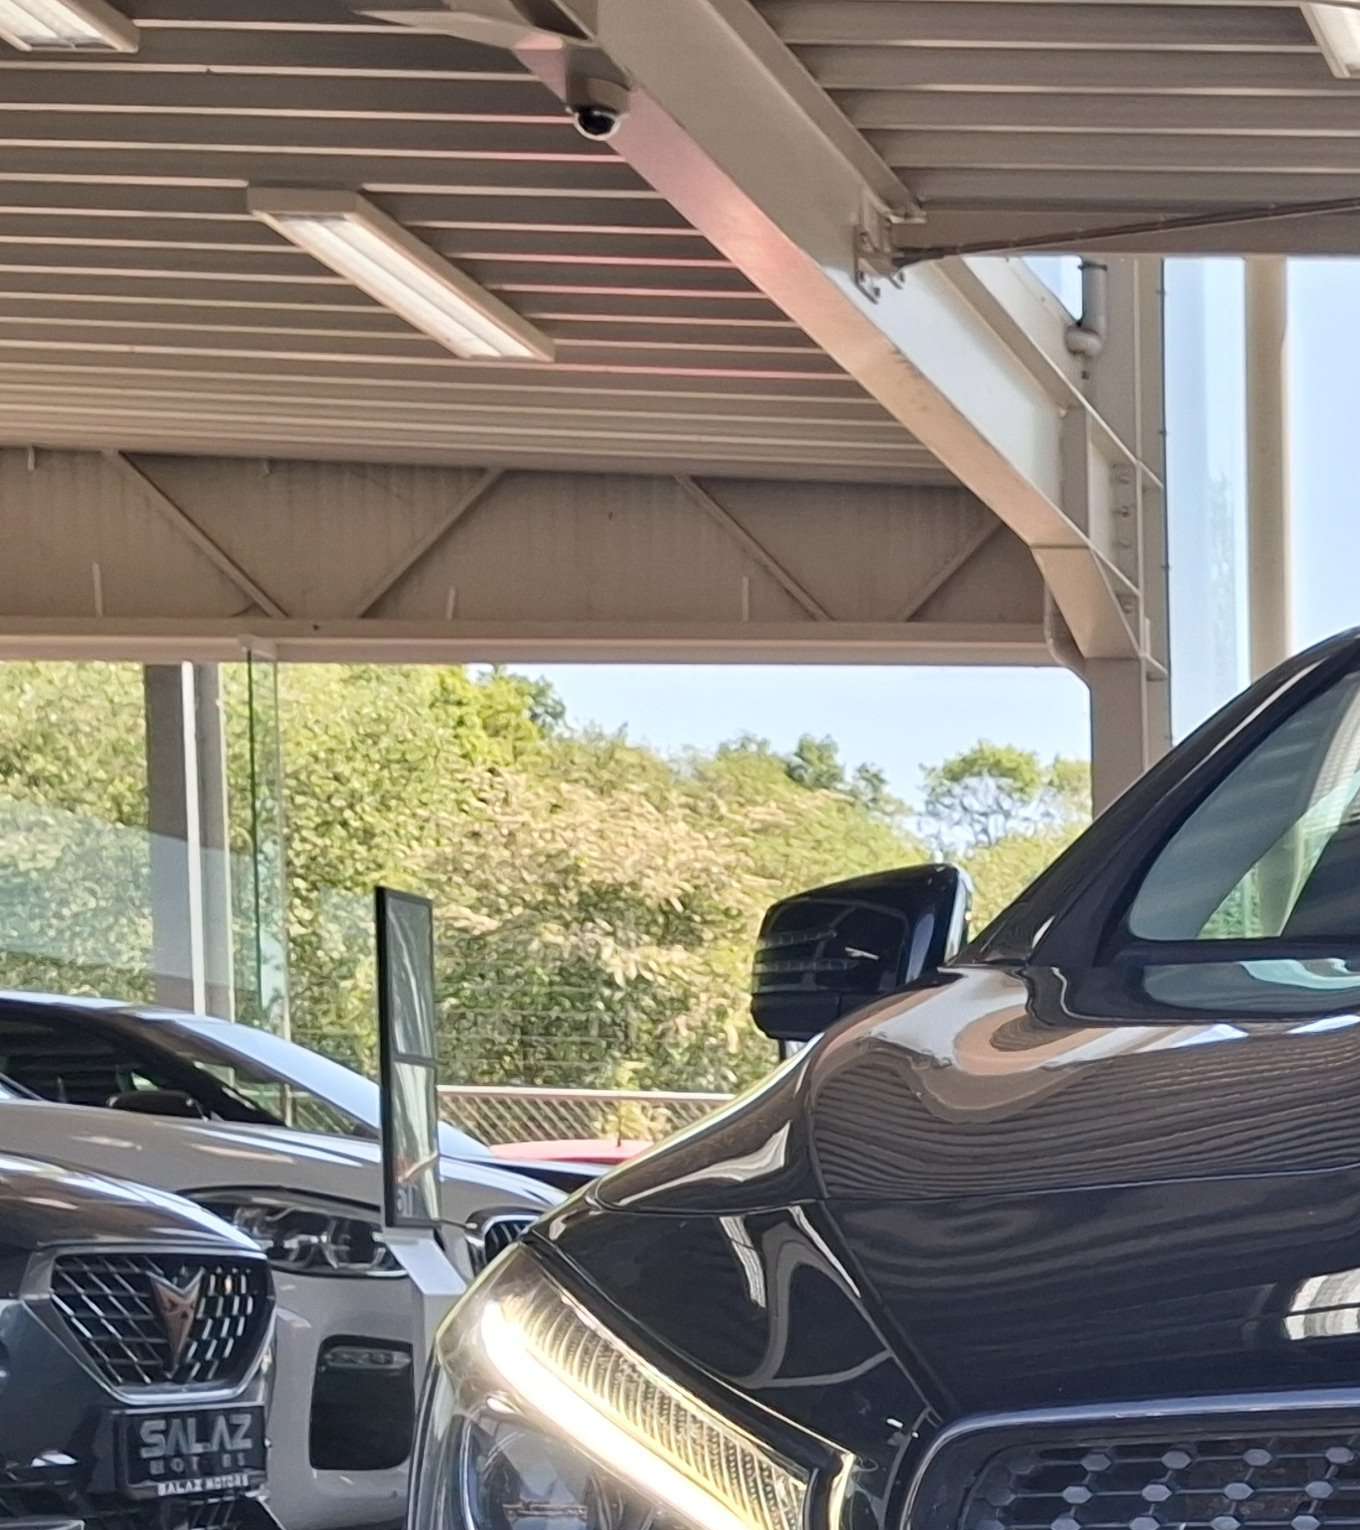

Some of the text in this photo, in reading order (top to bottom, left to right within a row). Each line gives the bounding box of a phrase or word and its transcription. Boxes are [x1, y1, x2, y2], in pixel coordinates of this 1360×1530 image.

[140, 1413, 253, 1459] SALAZ
[157, 1473, 250, 1497] SALAZ MOTORS
